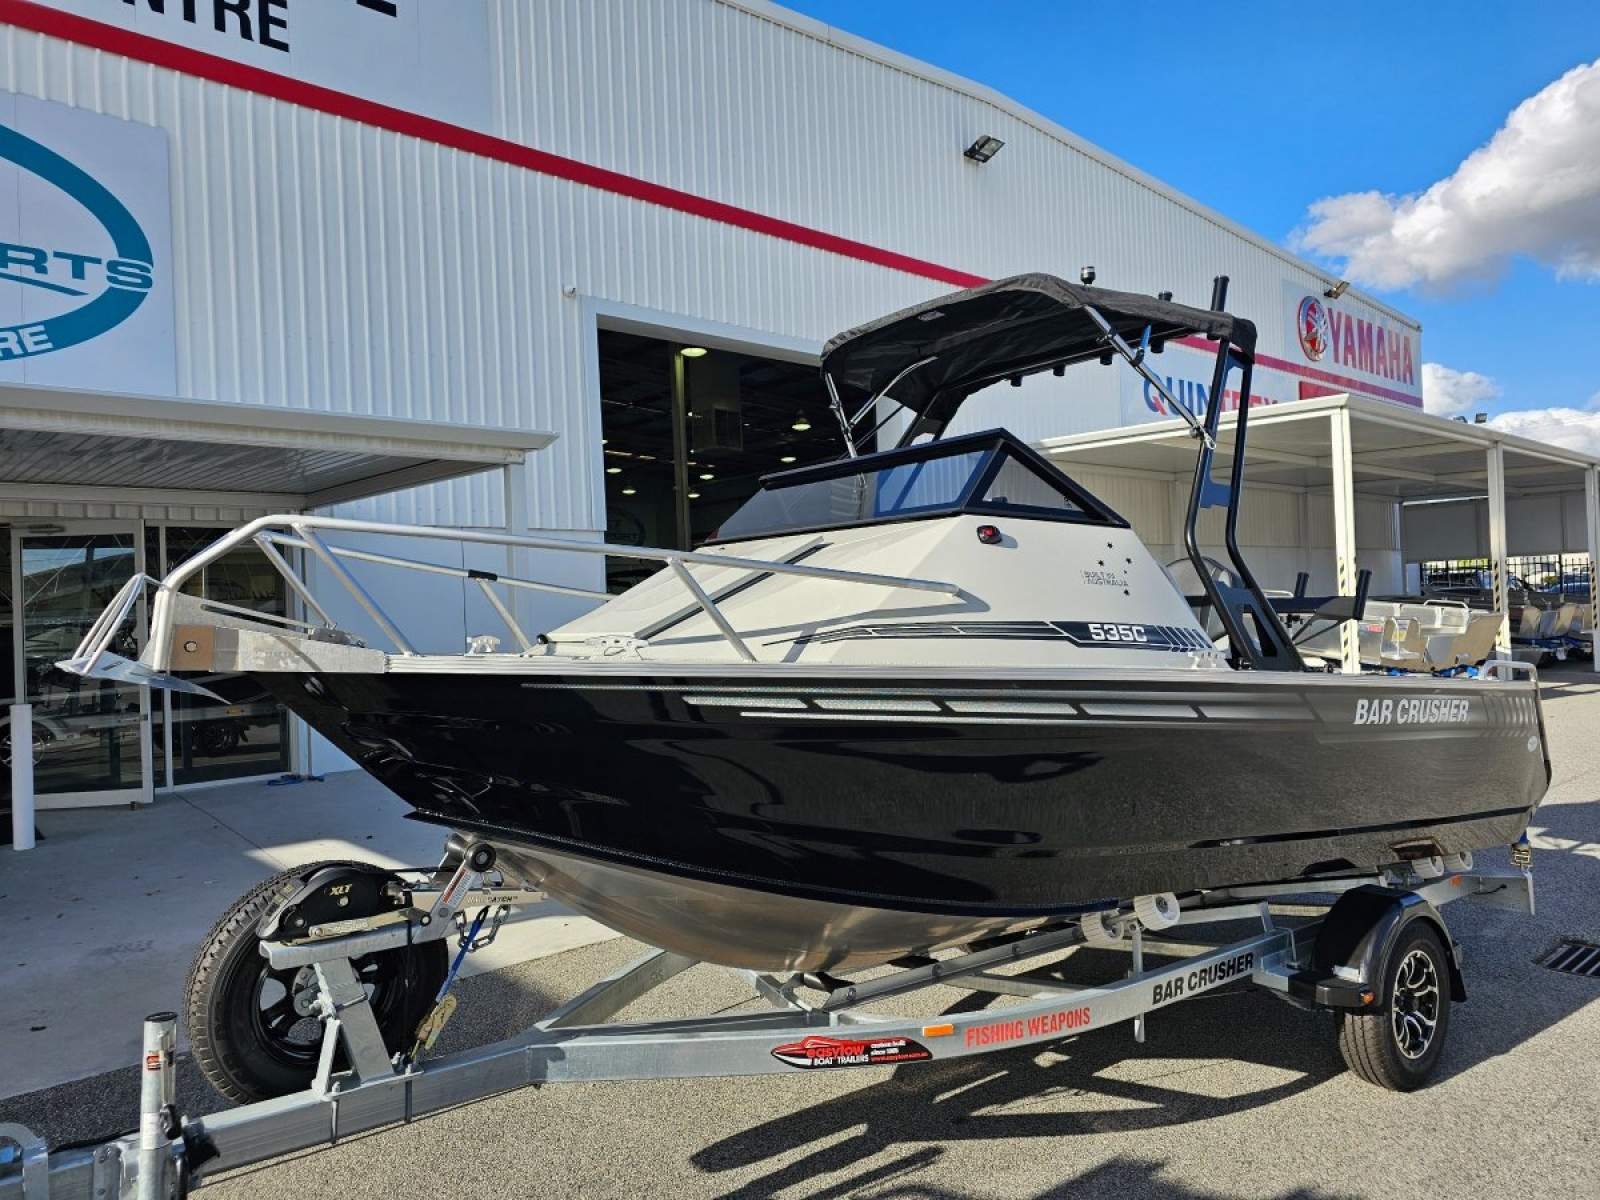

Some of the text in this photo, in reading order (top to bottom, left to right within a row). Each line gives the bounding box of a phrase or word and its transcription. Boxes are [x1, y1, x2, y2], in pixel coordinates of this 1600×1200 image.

[122, 0, 290, 53] RE
[1327, 307, 1415, 385] YAMAHA
[1086, 578, 1129, 587] AUSTRALIA
[1088, 623, 1147, 642] 535C
[1353, 698, 1470, 725] BAR CRUSHER
[329, 883, 353, 896] XLT
[1152, 952, 1254, 1005] BAR CRUSHER
[965, 1007, 1091, 1047] FISHING WEAPONS
[813, 1053, 869, 1066] BOAT TRAILERS
